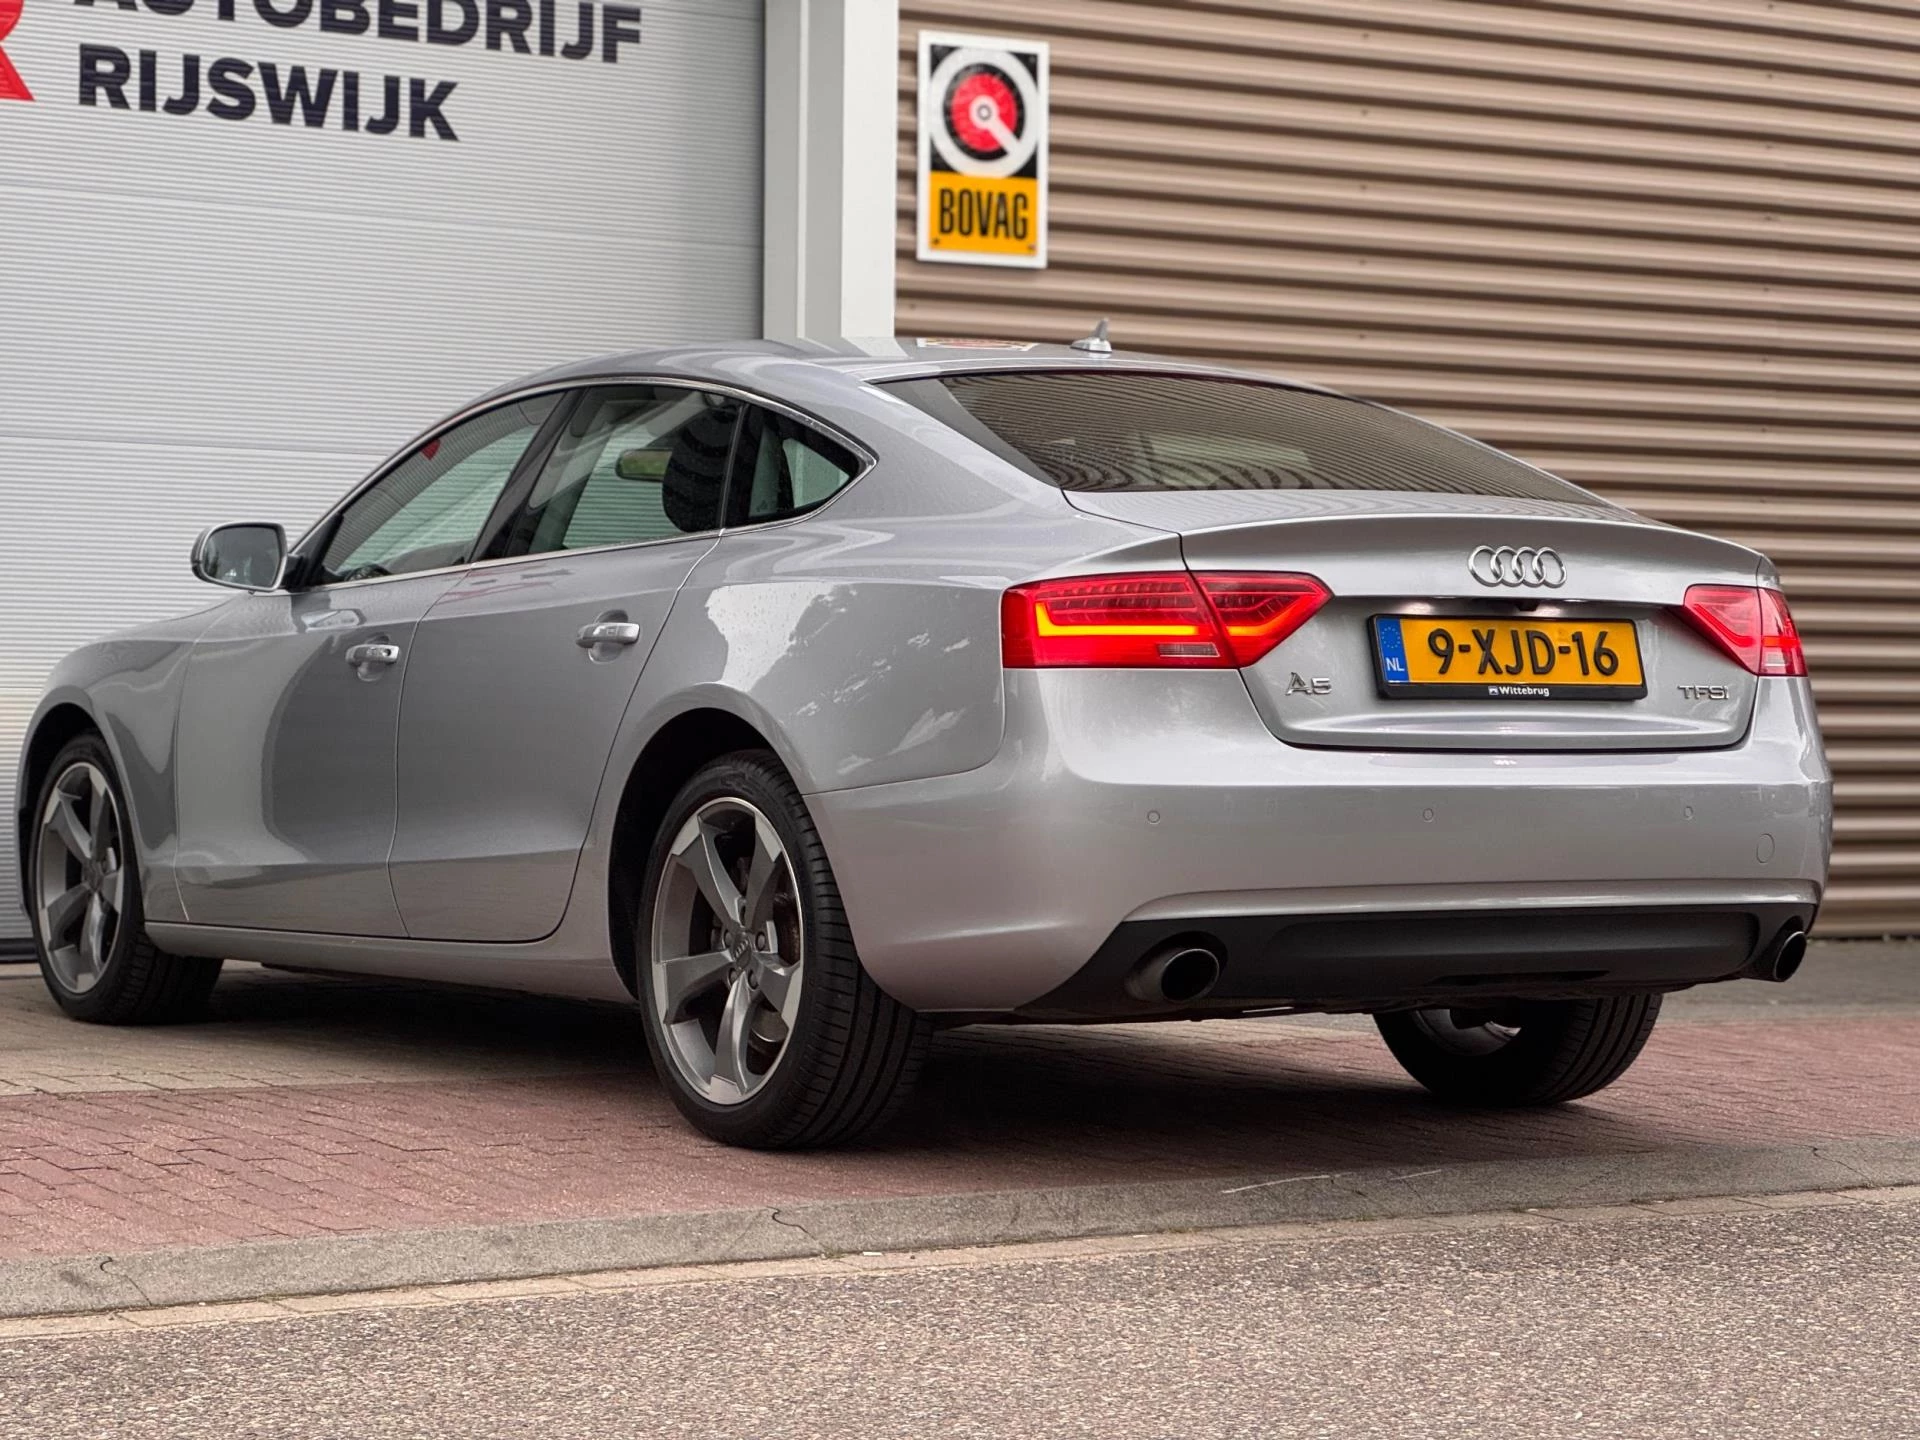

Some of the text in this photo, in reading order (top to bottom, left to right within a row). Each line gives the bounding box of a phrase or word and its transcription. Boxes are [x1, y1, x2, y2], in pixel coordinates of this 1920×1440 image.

[74, 0, 641, 63] BEDRIJF
[79, 43, 459, 141] RIJSWIJK
[939, 188, 1028, 240] BOVAG
[1386, 657, 1404, 671] NL
[1428, 627, 1619, 676] 9-XJD-16
[1285, 672, 1332, 695] A5
[1499, 686, 1550, 697] Wittebrug
[1677, 685, 1729, 700] TFSI
